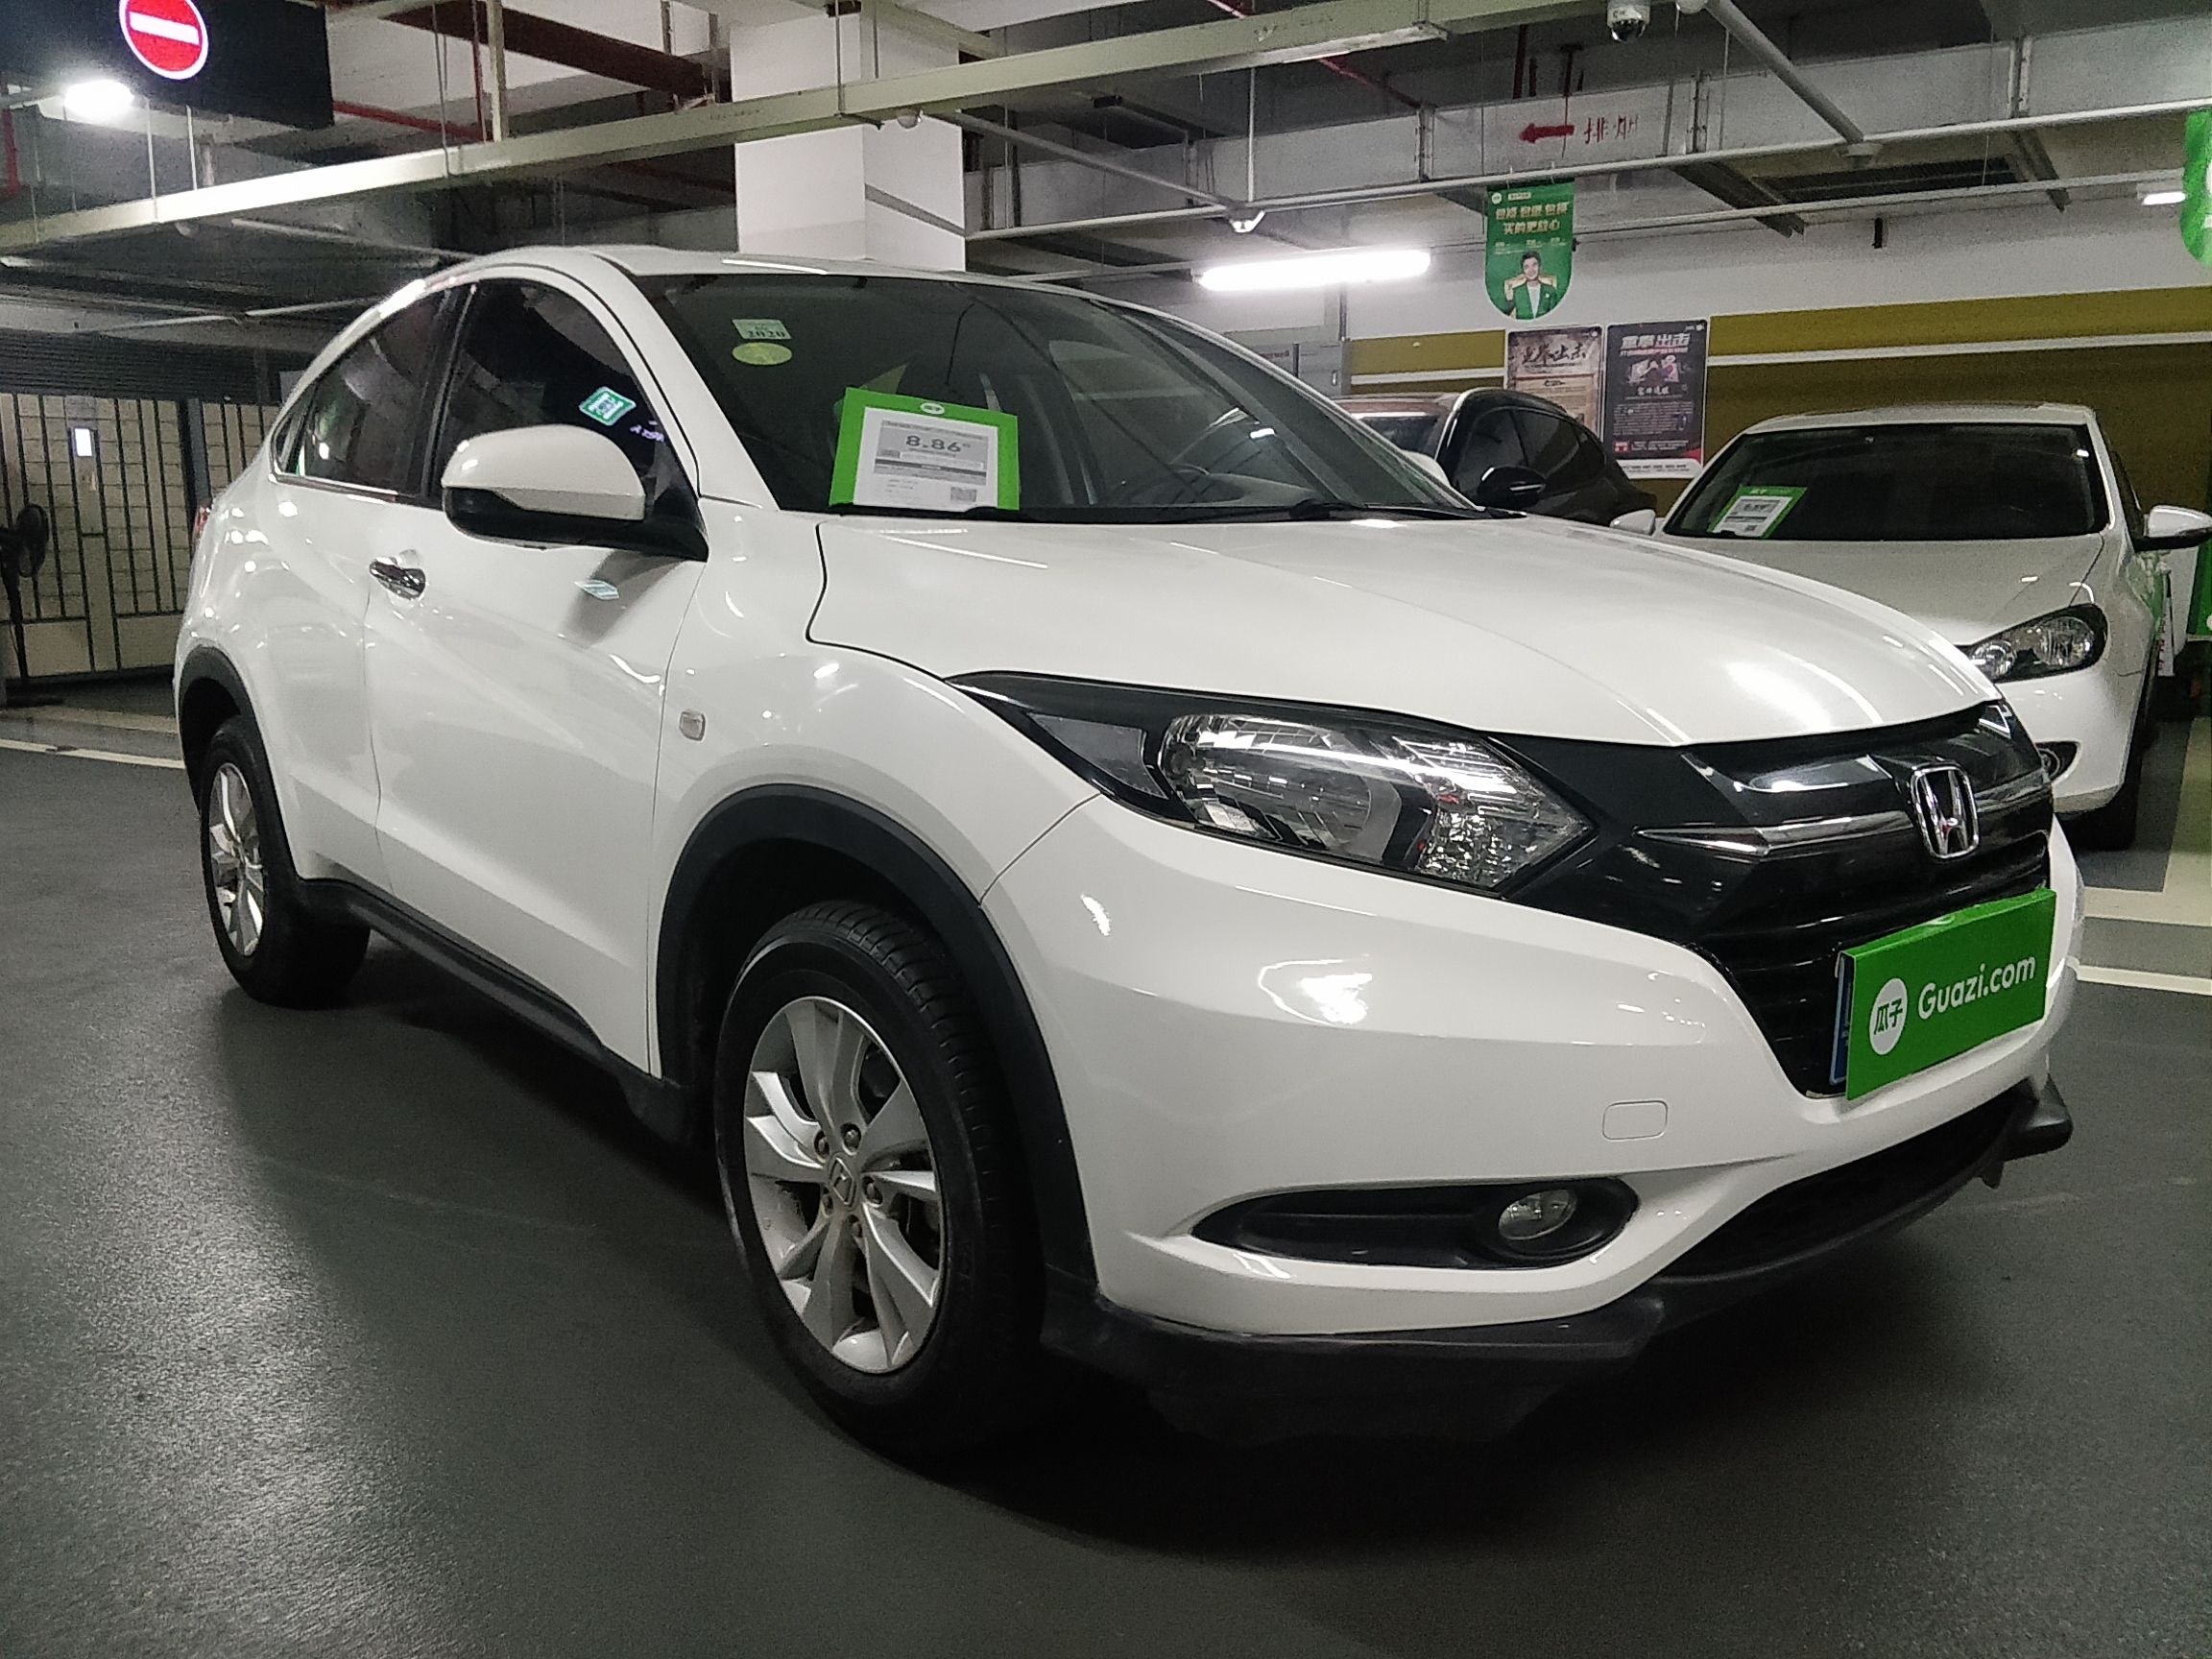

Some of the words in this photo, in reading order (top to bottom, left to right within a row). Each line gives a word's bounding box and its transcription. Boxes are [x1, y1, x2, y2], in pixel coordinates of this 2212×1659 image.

[906, 435, 961, 452] 8.86
[1918, 957, 2036, 1020] Guazi.com
[1874, 998, 1903, 1035] 瓜子
